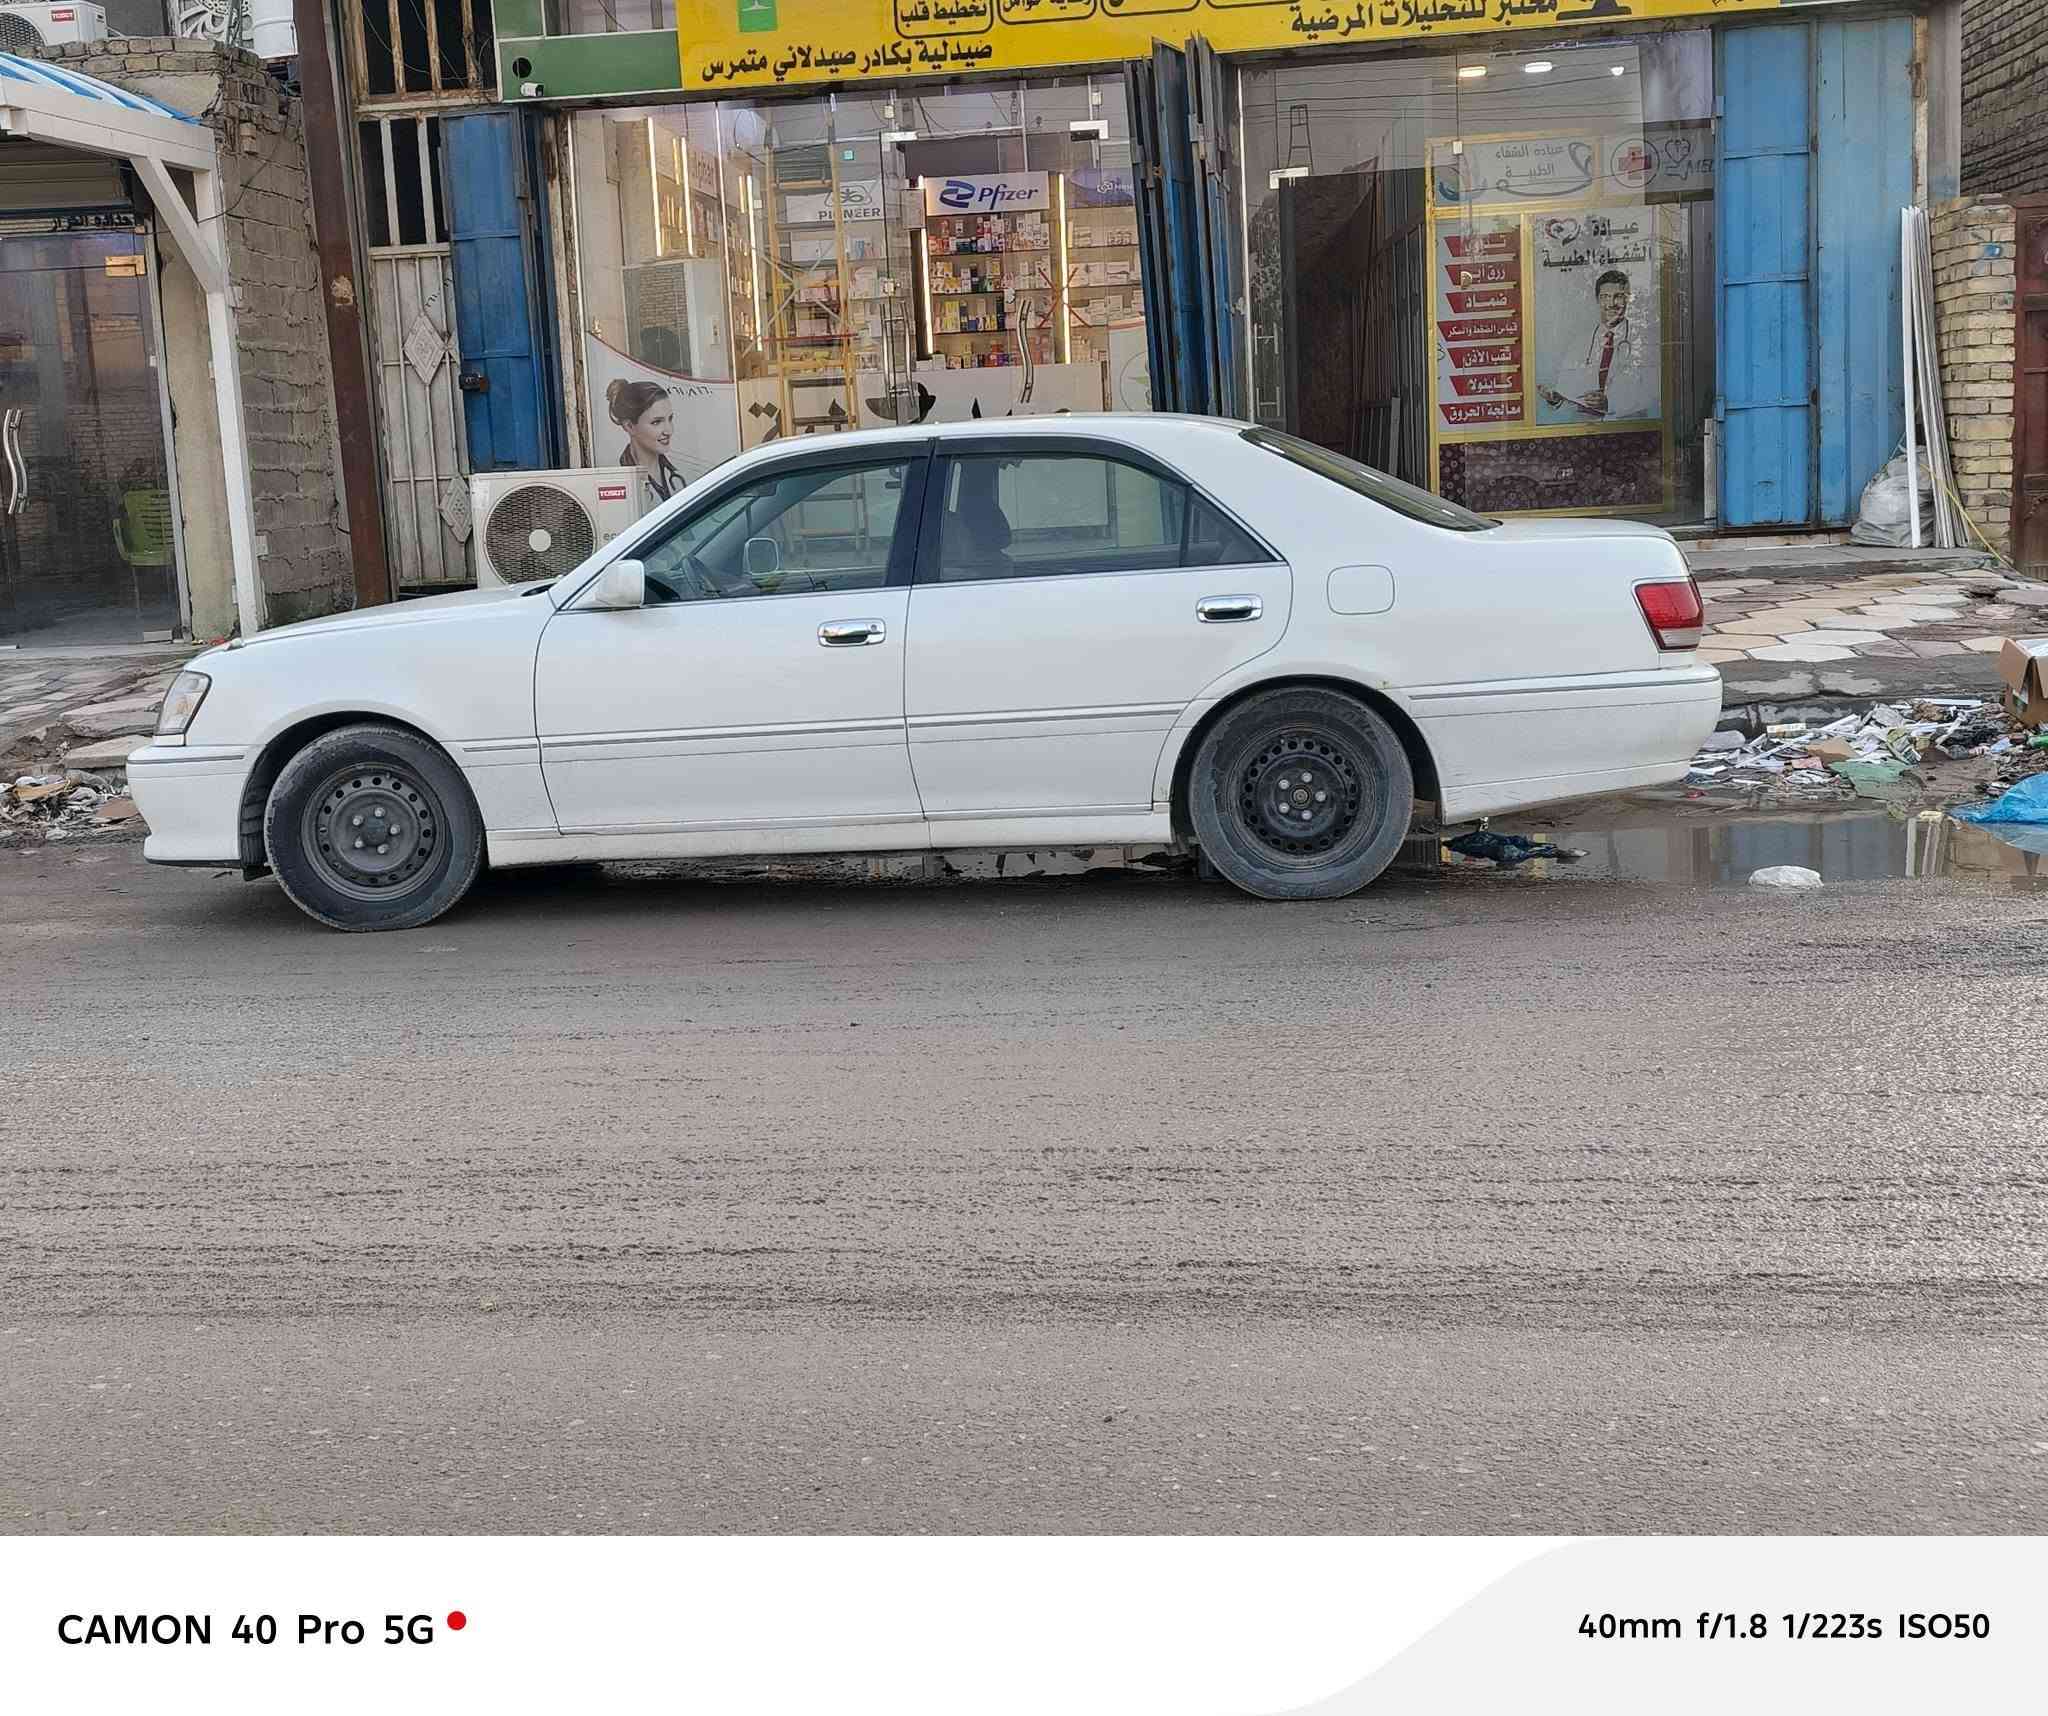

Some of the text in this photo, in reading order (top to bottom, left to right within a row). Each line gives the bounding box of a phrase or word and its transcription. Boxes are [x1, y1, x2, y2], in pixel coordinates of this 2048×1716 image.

[901, 0, 930, 28] قلب
[1291, 2, 1373, 40] المرضية
[702, 39, 993, 82] صيدلية بكادر صيدلاني متمرس
[978, 183, 1038, 210] Pfizer
[818, 207, 881, 220] PINEER
[1591, 218, 1640, 240] عيادة
[1542, 248, 1597, 273] الطبية
[1464, 292, 1508, 309] ضماد
[1496, 321, 1519, 335] قياس
